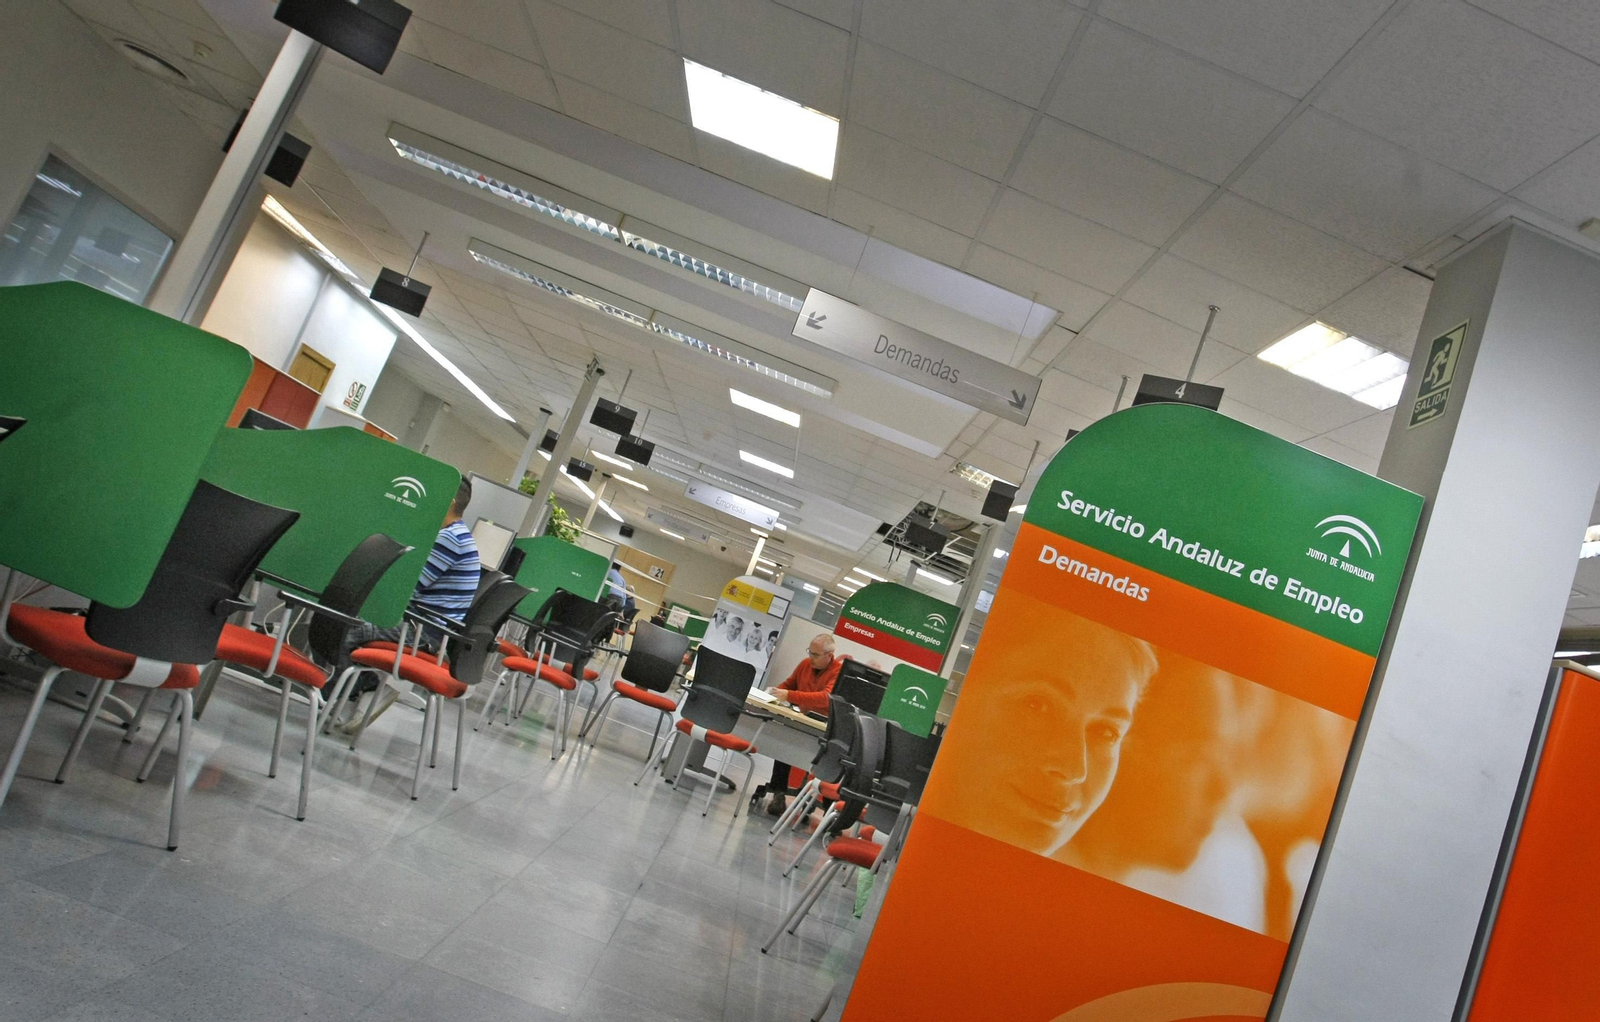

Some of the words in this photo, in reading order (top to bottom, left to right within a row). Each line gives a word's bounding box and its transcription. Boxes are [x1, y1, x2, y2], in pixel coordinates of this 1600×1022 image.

[402, 277, 409, 287] 8
[874, 334, 960, 384] Demandas
[1174, 382, 1187, 399] 4
[1415, 391, 1447, 413] SALIDA
[634, 437, 643, 445] 10
[715, 496, 747, 515] Empresas
[928, 521, 935, 529] 7
[1056, 489, 1145, 539] Servicio
[1148, 527, 1245, 578] Andaluz
[1249, 567, 1279, 590] de
[1283, 579, 1364, 624] Empleo
[1305, 547, 1328, 563] JUNTA
[1329, 556, 1339, 568] DE
[654, 568, 665, 579] 21
[1037, 544, 1150, 602] Demandas
[844, 622, 875, 638] Empresas
[849, 606, 876, 621] Servicio
[876, 617, 905, 633] Andaluz
[905, 628, 915, 636] de
[915, 632, 941, 646] Empleo
